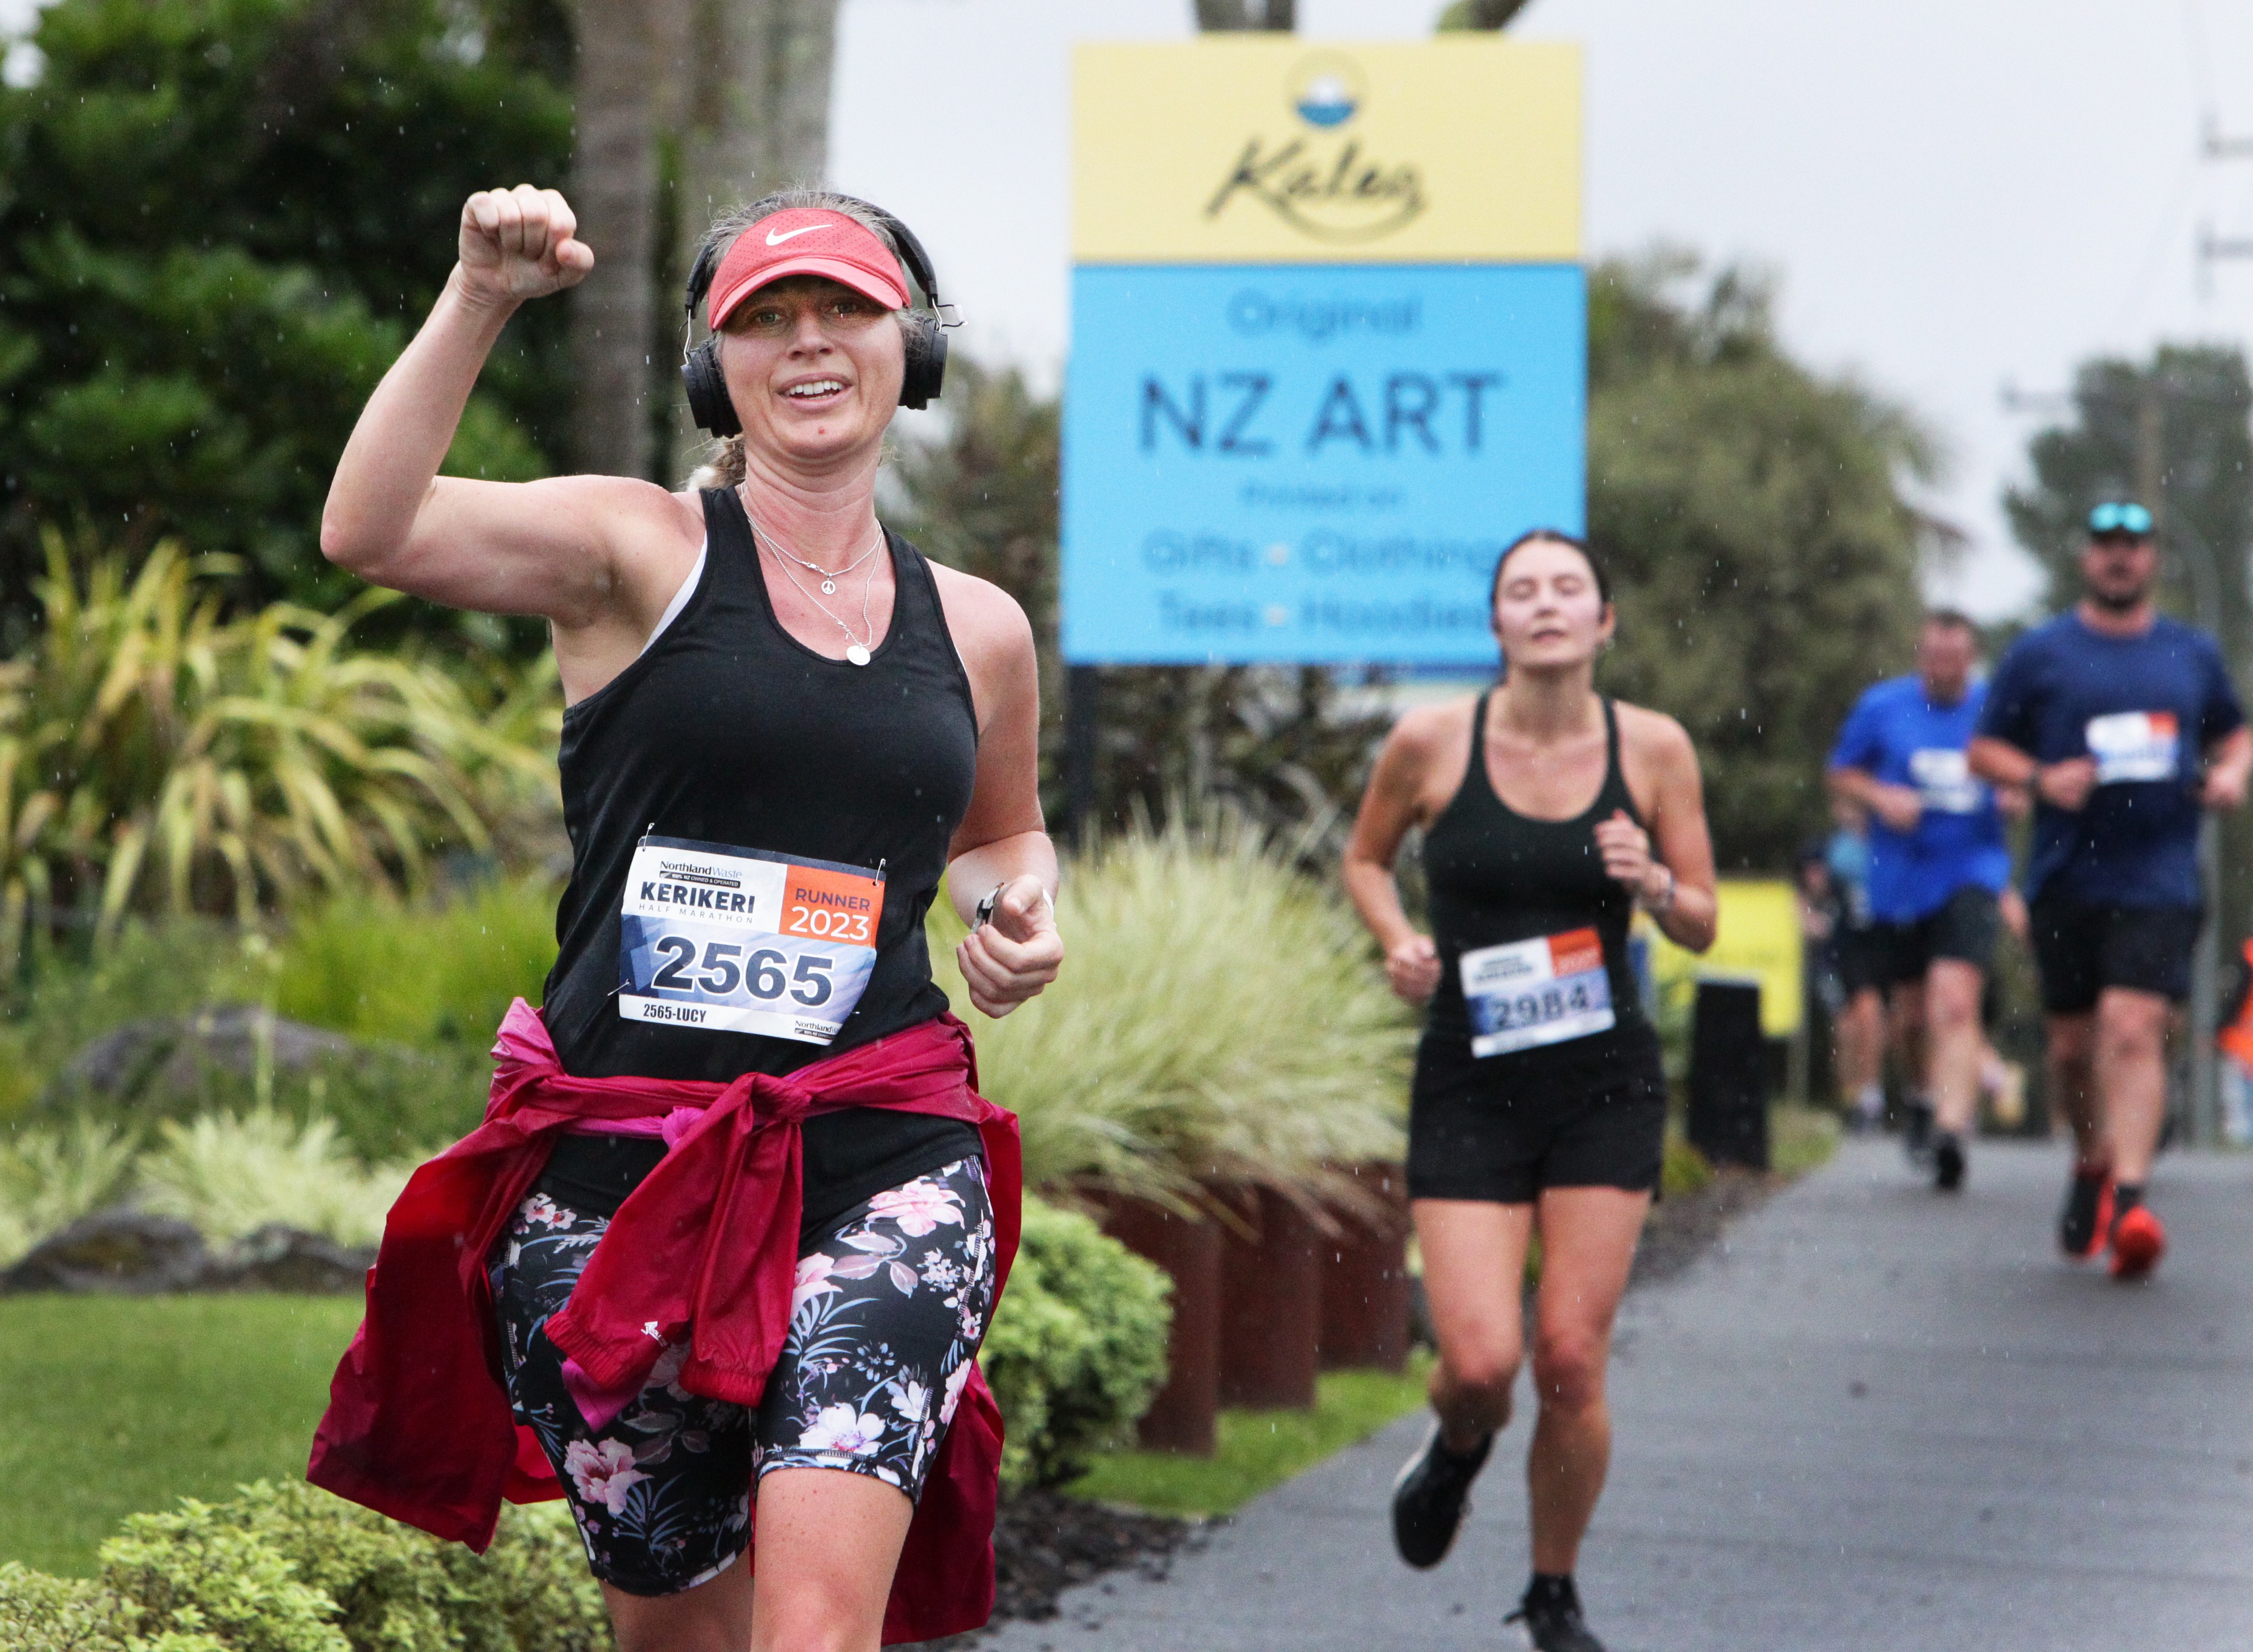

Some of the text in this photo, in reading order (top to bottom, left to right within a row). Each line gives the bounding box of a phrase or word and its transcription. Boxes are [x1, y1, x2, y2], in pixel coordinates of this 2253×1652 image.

[1227, 290, 1423, 346] Original
[1138, 369, 1509, 458] NZ ART
[1140, 530, 1498, 578] Gifts Clothing
[1153, 591, 1259, 636] Tees
[640, 881, 756, 914] KERIKERI
[713, 879, 739, 887] OPERATED
[795, 888, 871, 912] RUNNER
[639, 903, 753, 924] HALF MARATHON
[789, 906, 870, 941] 2023
[651, 934, 836, 1007] 2565
[643, 1003, 707, 1024] 2565-LUCY
[1491, 983, 1590, 1032] 2984
